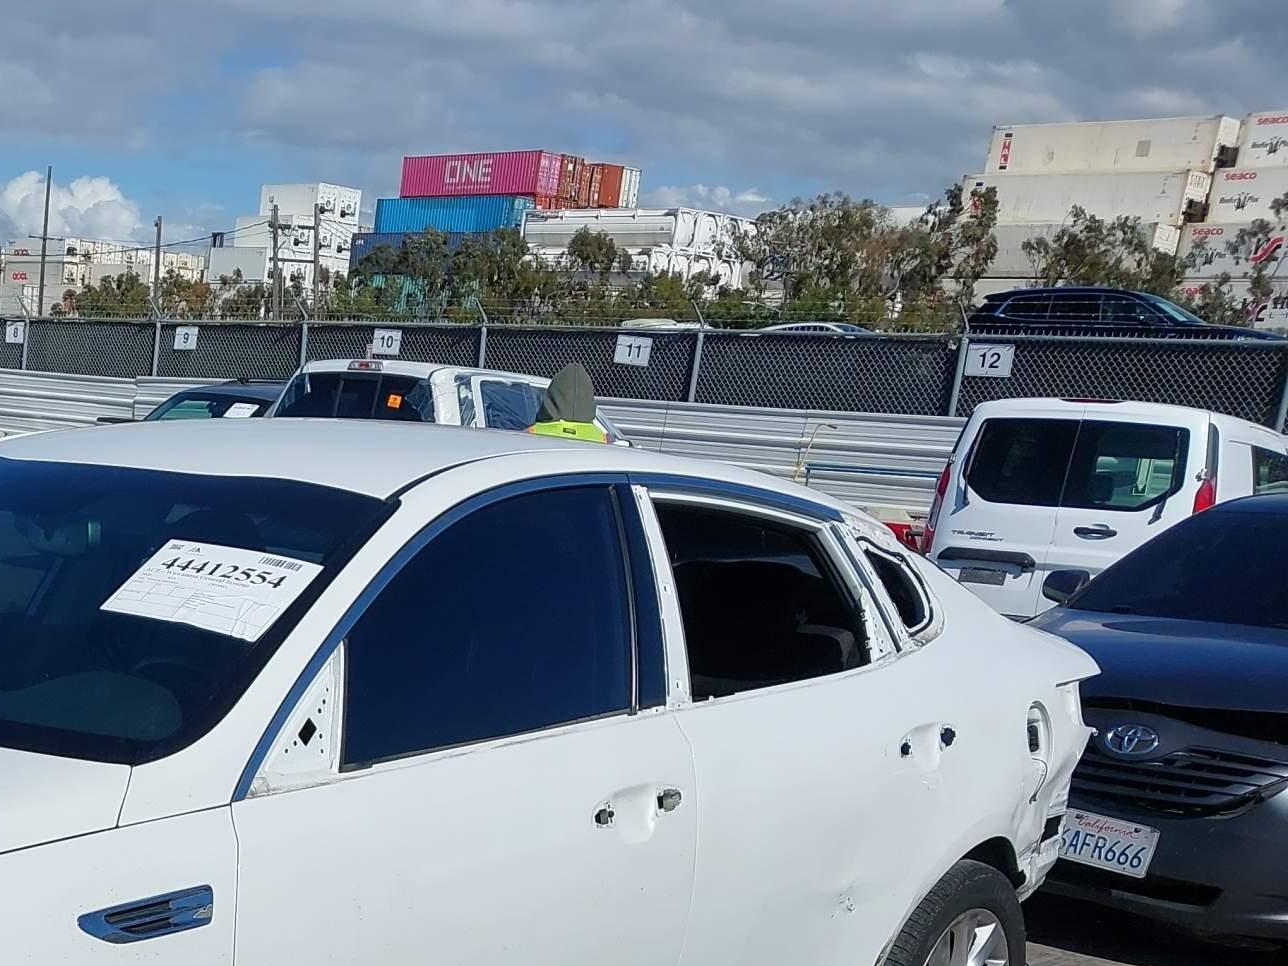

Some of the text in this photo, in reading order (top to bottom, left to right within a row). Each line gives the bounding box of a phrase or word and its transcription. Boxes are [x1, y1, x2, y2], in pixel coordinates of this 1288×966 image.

[445, 159, 492, 183] ONE
[1224, 171, 1257, 181] seaco
[1192, 227, 1224, 236] seaco
[13, 327, 19, 338] 8
[183, 332, 190, 344] 9
[378, 335, 394, 349] 10
[625, 343, 643, 359] 11
[979, 352, 1001, 369] 12
[161, 557, 288, 588] 44412554
[1078, 815, 1139, 840] California
